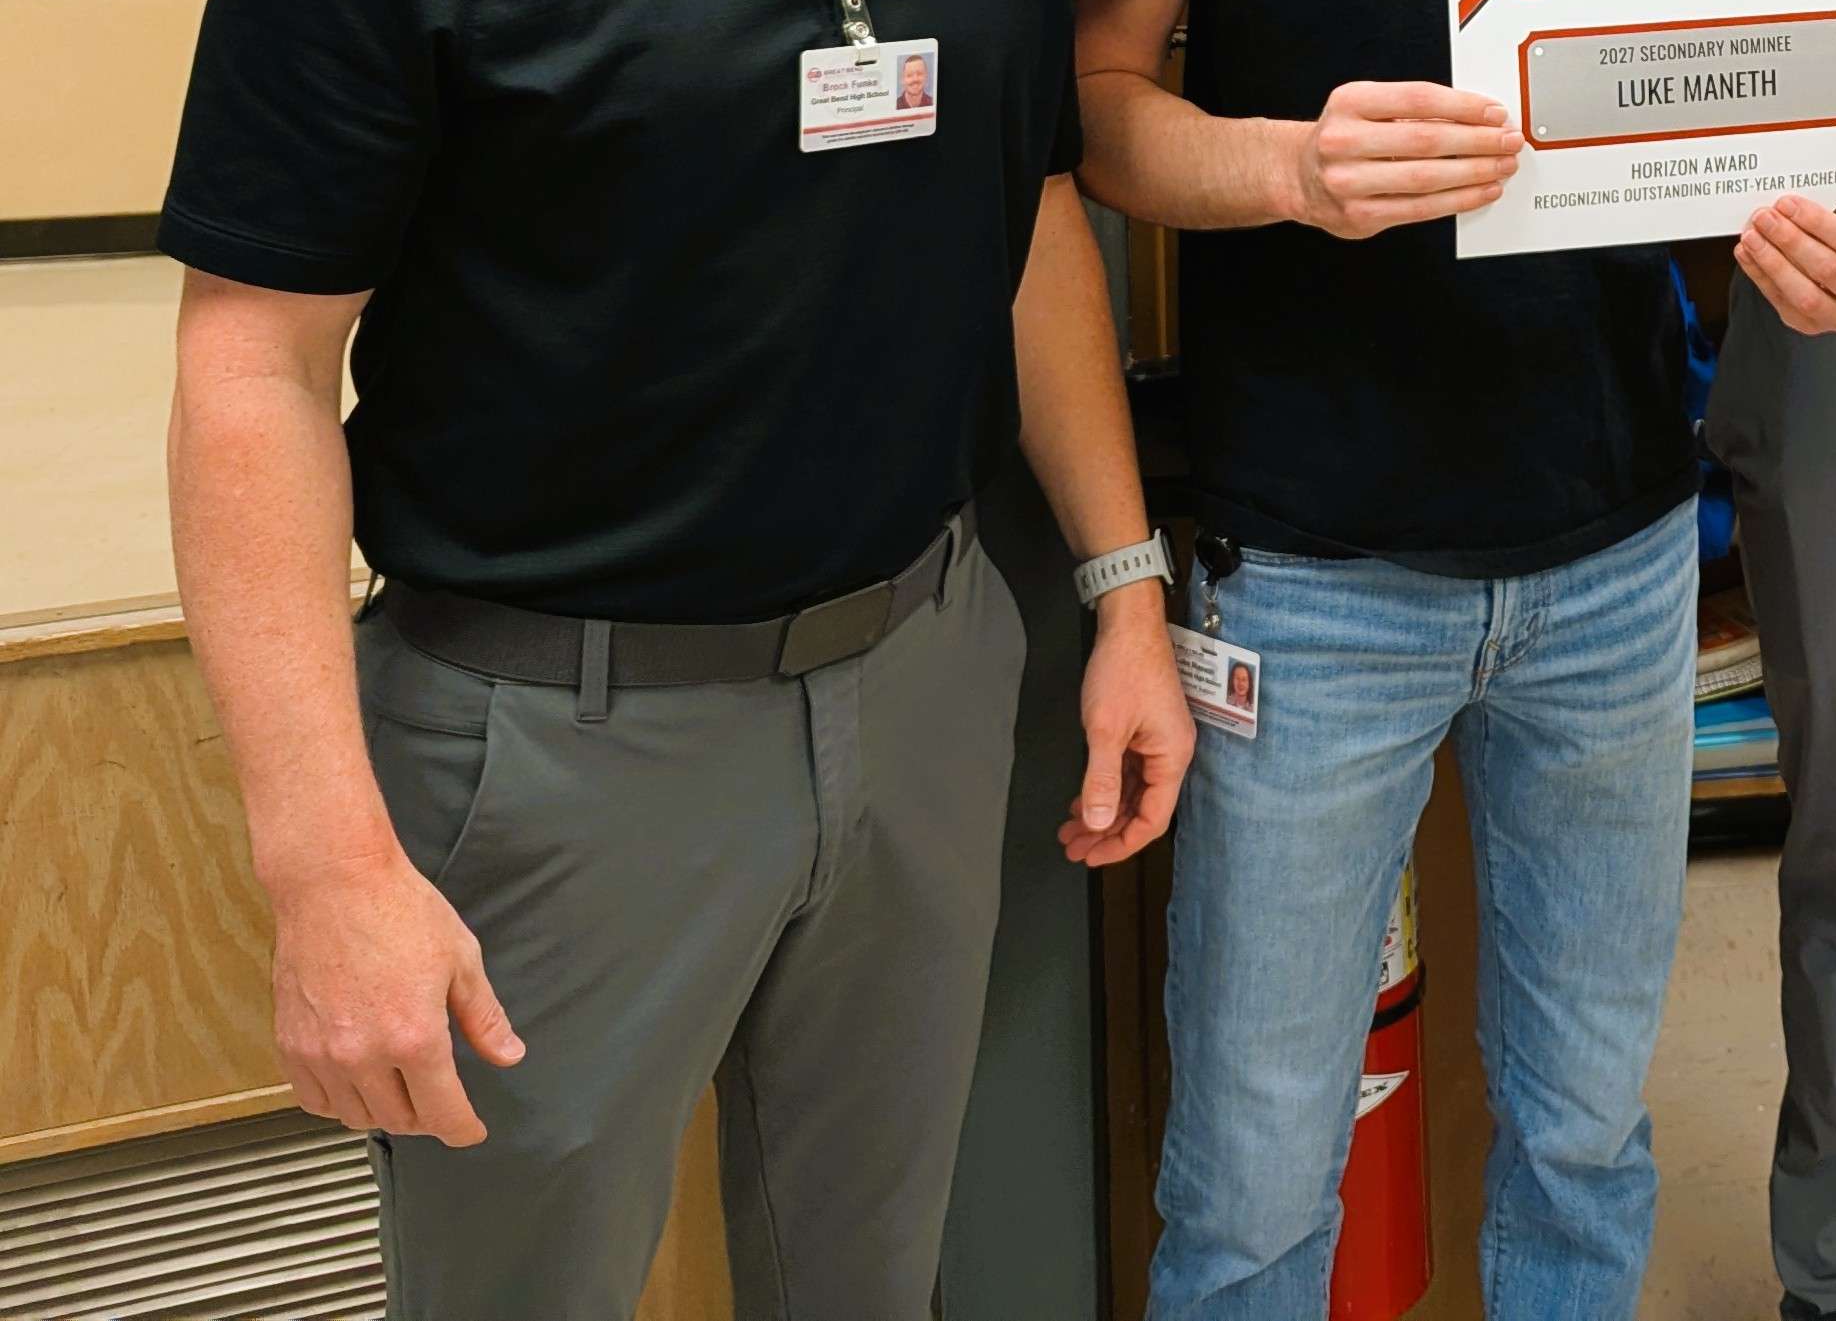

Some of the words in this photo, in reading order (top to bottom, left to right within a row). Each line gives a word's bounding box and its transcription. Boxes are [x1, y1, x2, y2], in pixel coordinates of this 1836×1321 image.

[1599, 47, 1636, 66] 2027
[1639, 40, 1724, 63] SECONDARY
[1729, 35, 1792, 57] NOMINEE
[1617, 76, 1676, 109] LUKE
[1682, 69, 1777, 103] MANETH
[1630, 158, 1698, 180] HORIZON
[1703, 153, 1758, 174] AWARD
[1533, 189, 1619, 210] RECOGNIZING
[1623, 182, 1710, 204] OUTSTANDING
[1714, 175, 1785, 198] FIRST-YEAR
